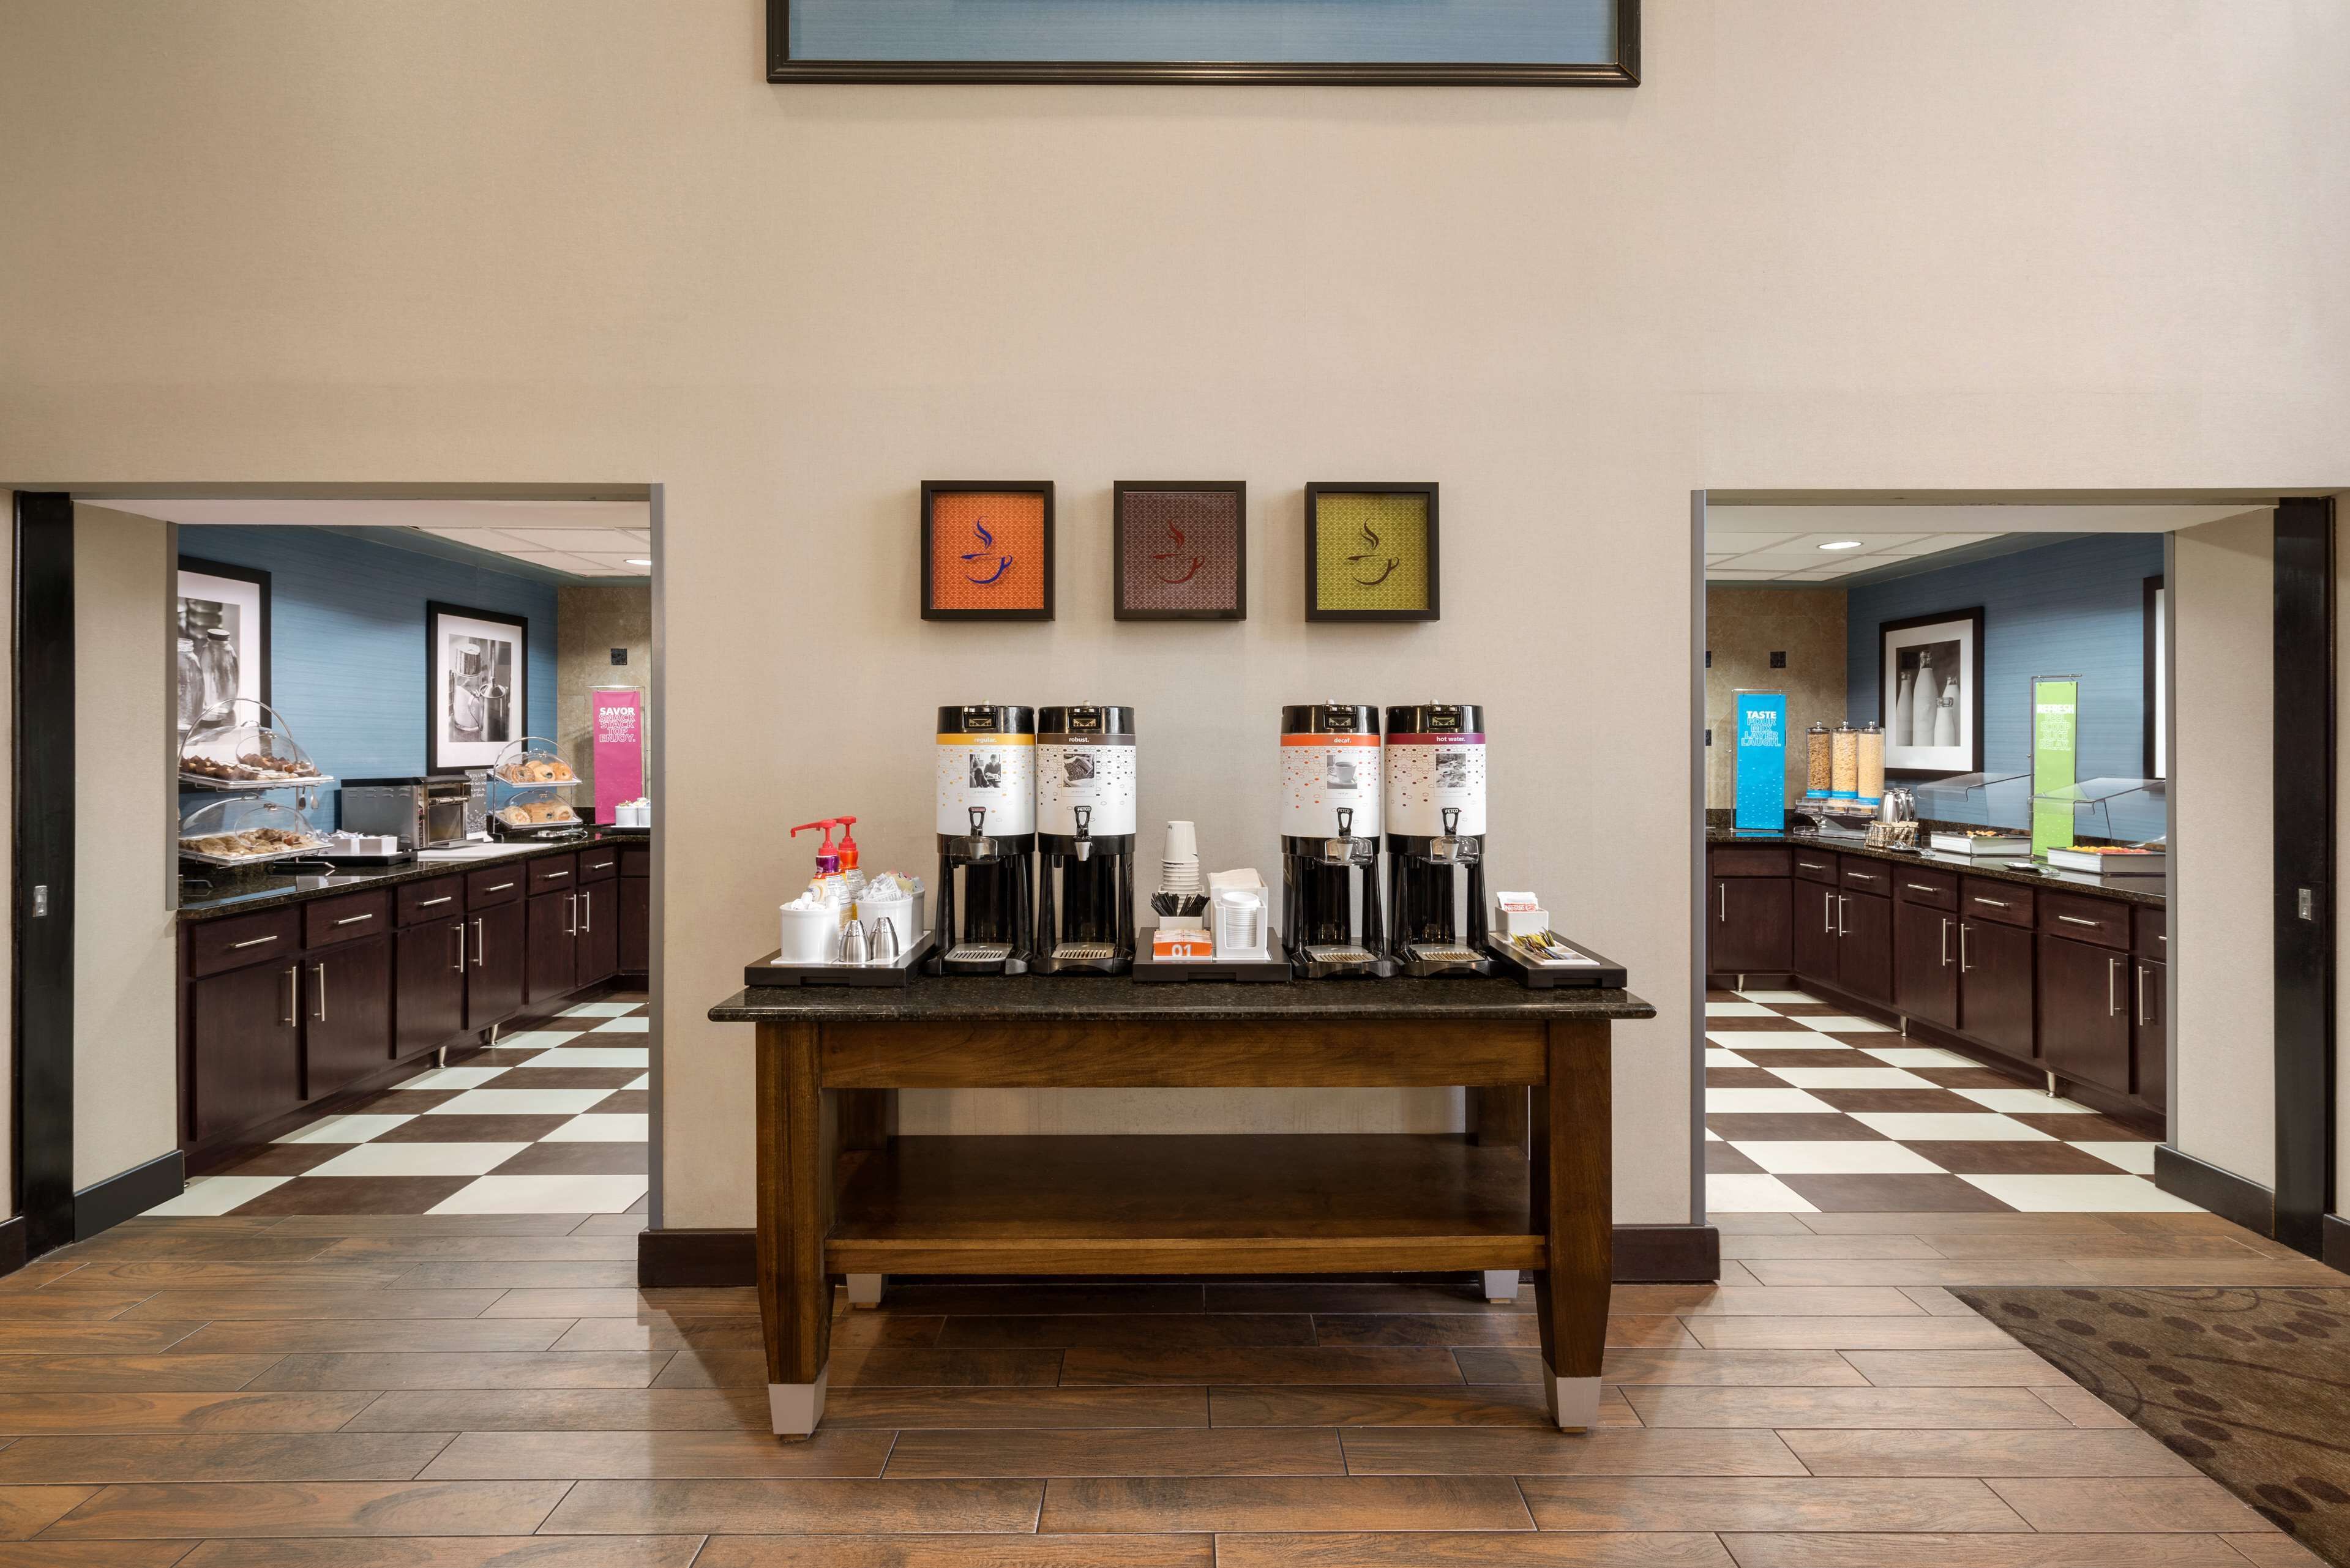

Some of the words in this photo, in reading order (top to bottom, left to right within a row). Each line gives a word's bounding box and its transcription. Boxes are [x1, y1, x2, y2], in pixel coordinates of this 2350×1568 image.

[2037, 704, 2075, 714] REFRESH
[2040, 721, 2071, 730] SCOOP
[599, 734, 636, 742] ENJOY.
[2042, 730, 2068, 739] SLICE
[1741, 737, 1781, 746] LAUGH.
[1172, 944, 1192, 957] 01
